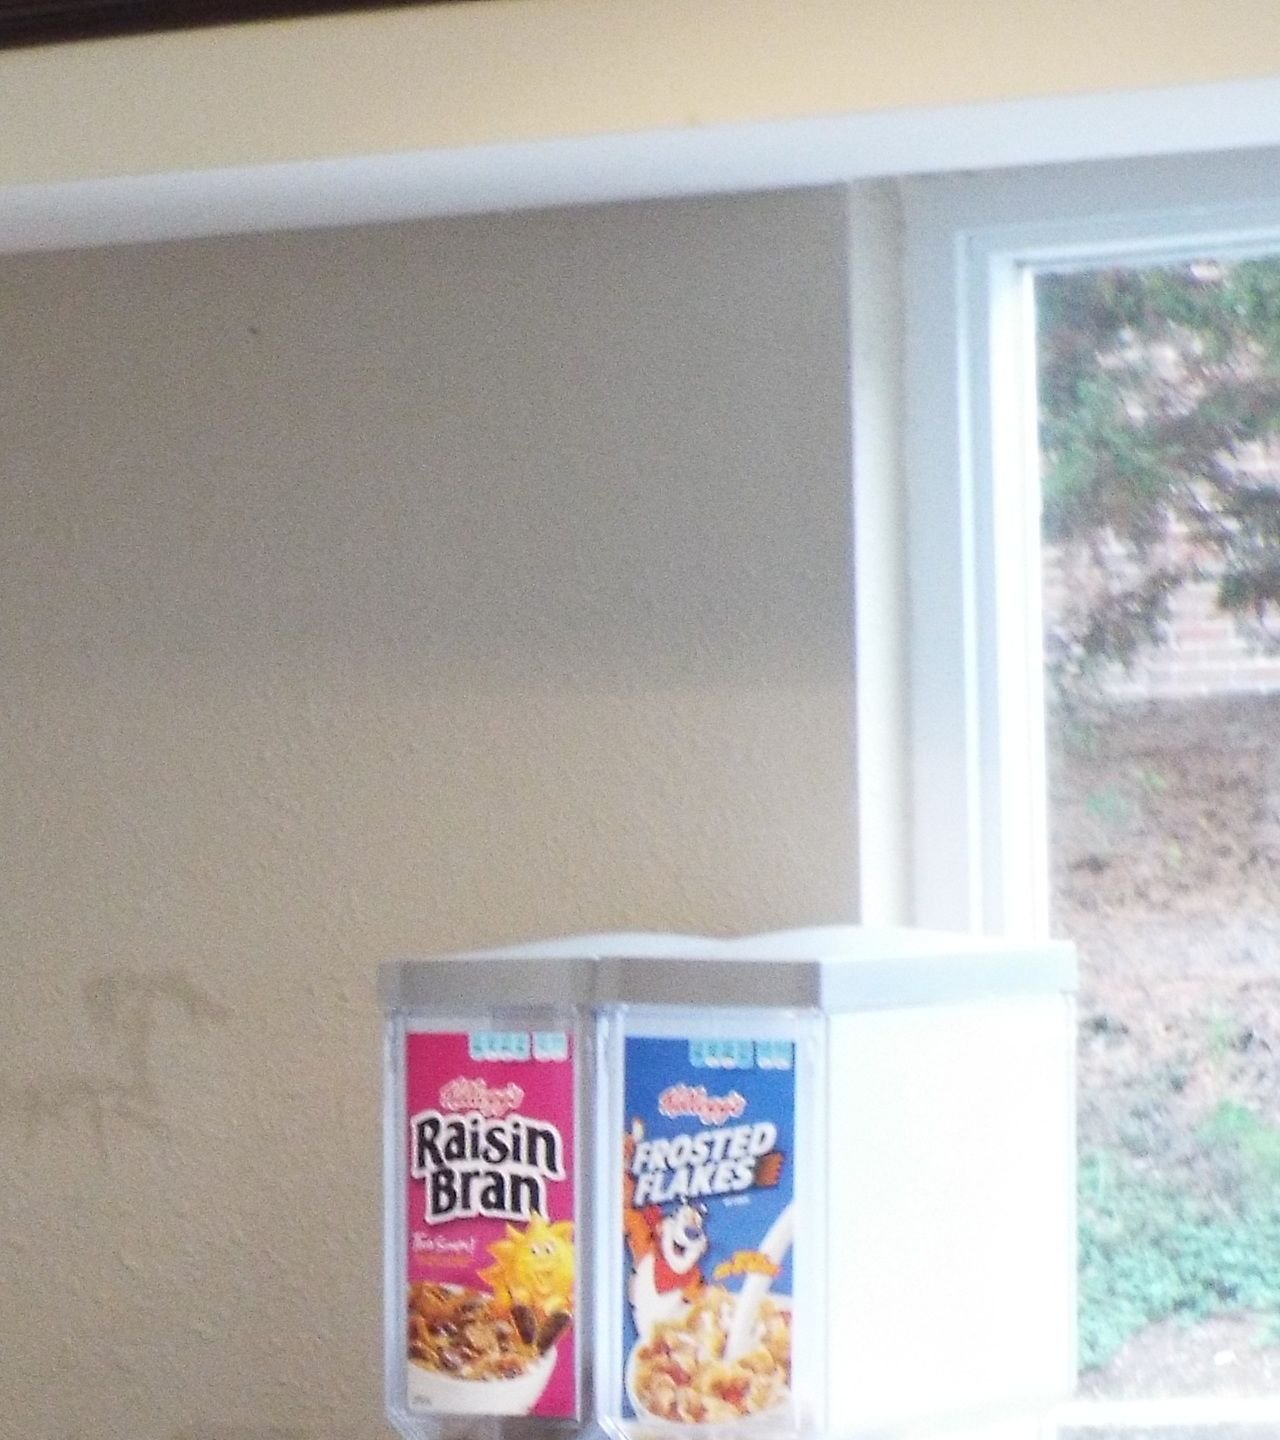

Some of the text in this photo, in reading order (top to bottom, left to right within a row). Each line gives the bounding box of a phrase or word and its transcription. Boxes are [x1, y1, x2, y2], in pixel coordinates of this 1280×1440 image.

[415, 1114, 560, 1175] Raisin
[632, 1121, 778, 1176] FROSTED
[429, 1166, 544, 1217] Bran
[633, 1157, 756, 1209] FLAKES
